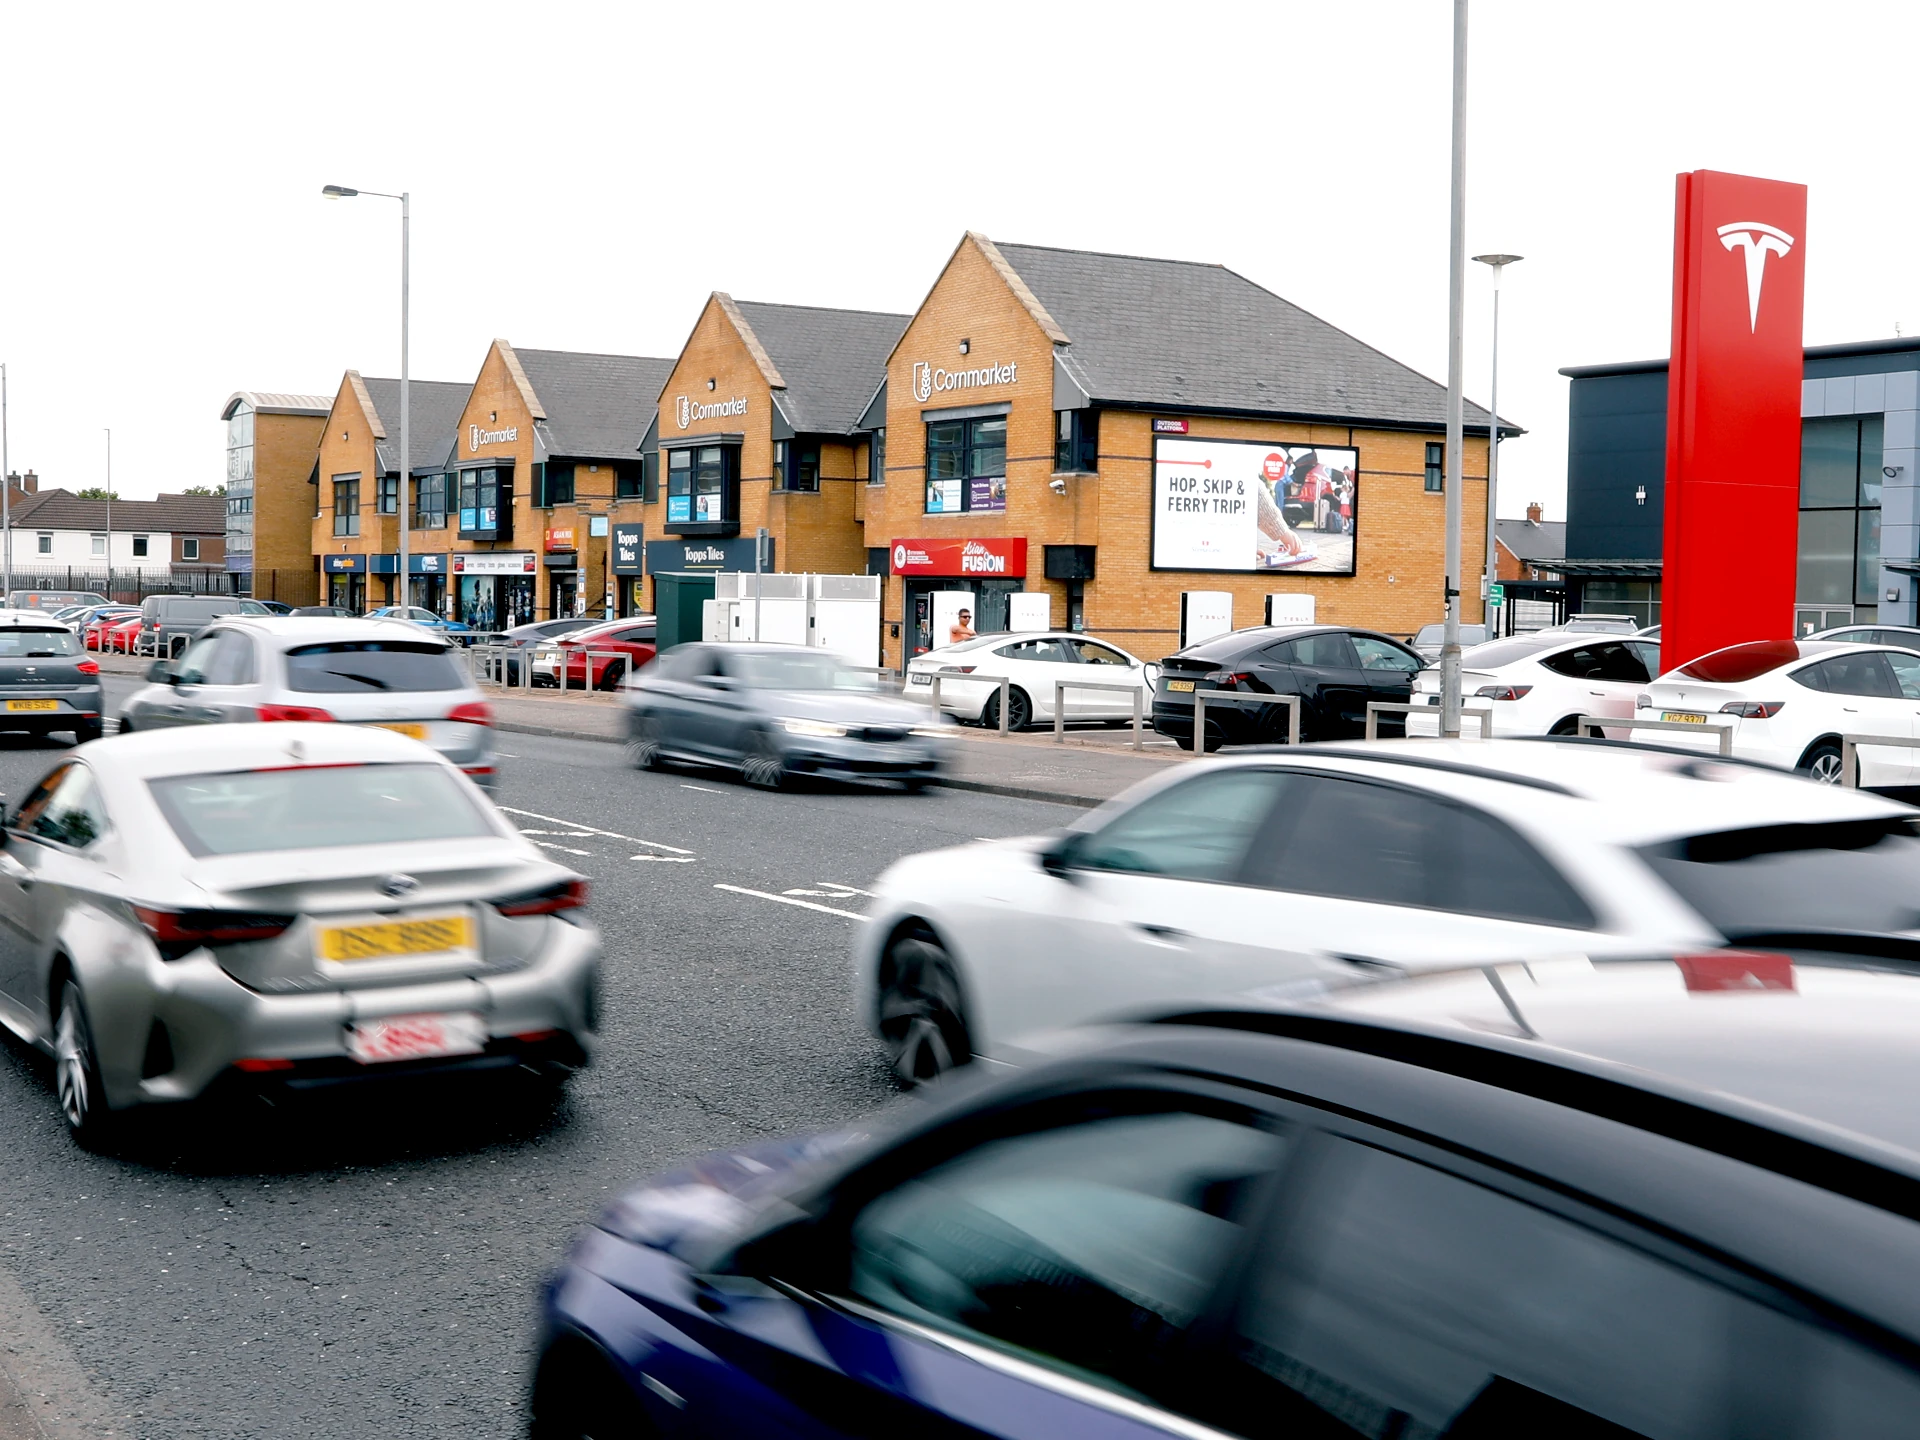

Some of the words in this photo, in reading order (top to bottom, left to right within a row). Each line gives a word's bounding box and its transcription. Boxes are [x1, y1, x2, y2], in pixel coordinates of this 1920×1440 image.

[934, 361, 1017, 391] Cornmarket
[691, 396, 747, 420] Cornmarket
[480, 426, 518, 444] Cornmarket
[1169, 477, 1199, 495] HOP,
[1203, 478, 1233, 494] SKIP
[1236, 480, 1245, 495] &
[1168, 496, 1209, 513] FERRY
[1213, 498, 1245, 515] TRIP!
[617, 530, 638, 546] Topps
[619, 547, 635, 561] Tiles
[684, 546, 707, 563] Topps
[707, 546, 724, 560] Tiles
[961, 541, 985, 555] Asian
[1667, 712, 1682, 722] YGZ
